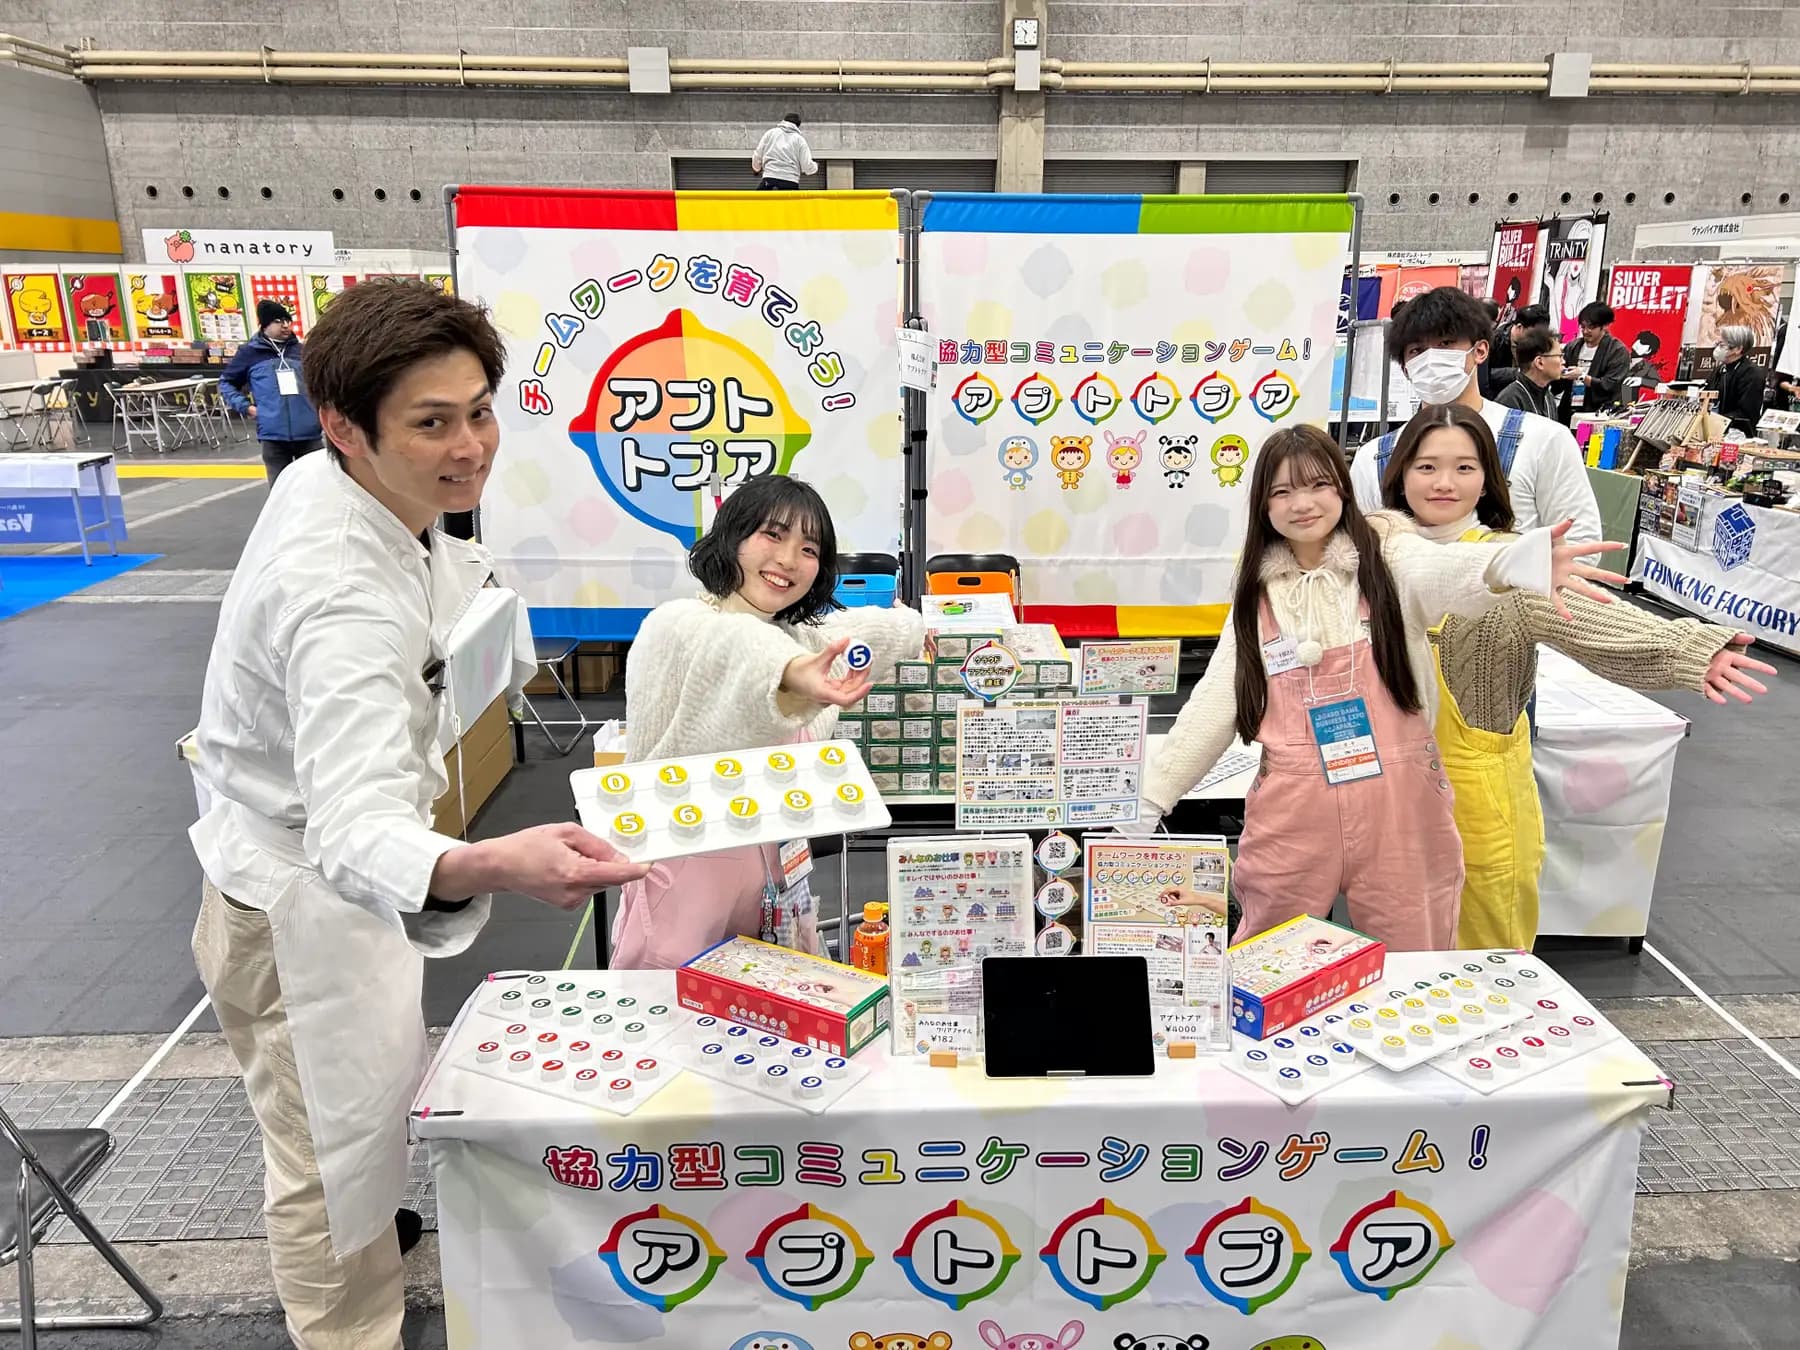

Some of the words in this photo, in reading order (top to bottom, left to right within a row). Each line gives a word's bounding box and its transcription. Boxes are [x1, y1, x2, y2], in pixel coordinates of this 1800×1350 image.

[204, 241, 312, 257] nanatory
[1498, 243, 1534, 267] BULLET
[1502, 229, 1522, 244] SILVER
[1611, 286, 1688, 310] BULLET
[1614, 271, 1661, 286] SILVER
[519, 254, 855, 416] チームワークを育てよう!
[939, 338, 1312, 364] 協力型コミュニケーションゲーム!
[608, 377, 773, 433] アプト
[622, 439, 776, 492] トプア
[1643, 557, 1716, 606] THINK!NG
[1714, 590, 1800, 636] FACTORY
[851, 647, 867, 666] 5
[607, 775, 625, 790] 0
[666, 767, 680, 782] 1
[720, 761, 737, 776] 2
[773, 754, 790, 769] 3
[826, 749, 840, 762] 4
[621, 815, 638, 832] 5
[679, 807, 696, 823] 6
[735, 798, 749, 815] 7
[790, 792, 807, 807] 8
[842, 785, 858, 800] 9
[503, 991, 519, 1000] 5
[534, 999, 549, 1008] 6
[564, 1007, 580, 1015] 7
[595, 1015, 611, 1023] 8
[626, 1023, 643, 1032] 9
[509, 1024, 524, 1033] 0
[539, 1033, 554, 1042] 1
[571, 1041, 587, 1051] 2
[604, 1050, 620, 1060] 3
[639, 1060, 654, 1069] 4
[699, 1016, 714, 1026] 0
[730, 1026, 745, 1036] 1
[761, 1036, 777, 1046] 2
[793, 1047, 809, 1057] 3
[828, 1058, 844, 1068] 4
[931, 1035, 954, 1043] ¥182
[1249, 1051, 1266, 1060] 0
[1276, 1038, 1293, 1048] 1
[1301, 1027, 1319, 1036] 2
[1471, 1059, 1489, 1068] 5
[1499, 1048, 1516, 1057] 6
[1524, 1037, 1540, 1046] 7
[1550, 1027, 1568, 1036] 8
[1575, 1016, 1592, 1025] 9
[479, 1042, 497, 1052] 5
[512, 1051, 529, 1061] 6
[545, 1060, 562, 1069] 7
[578, 1070, 595, 1080] 8
[612, 1079, 629, 1089] 9
[704, 1044, 720, 1053] 6
[736, 1055, 753, 1063] 7
[769, 1066, 785, 1076] 8
[803, 1077, 820, 1087] 9
[1281, 1068, 1298, 1078] 5
[1309, 1055, 1326, 1065] 6
[1334, 1043, 1349, 1053] 7
[544, 1125, 1491, 1193] 協力型コミュニケーションゲーム!
[626, 1214, 1434, 1293] アプトトプア
